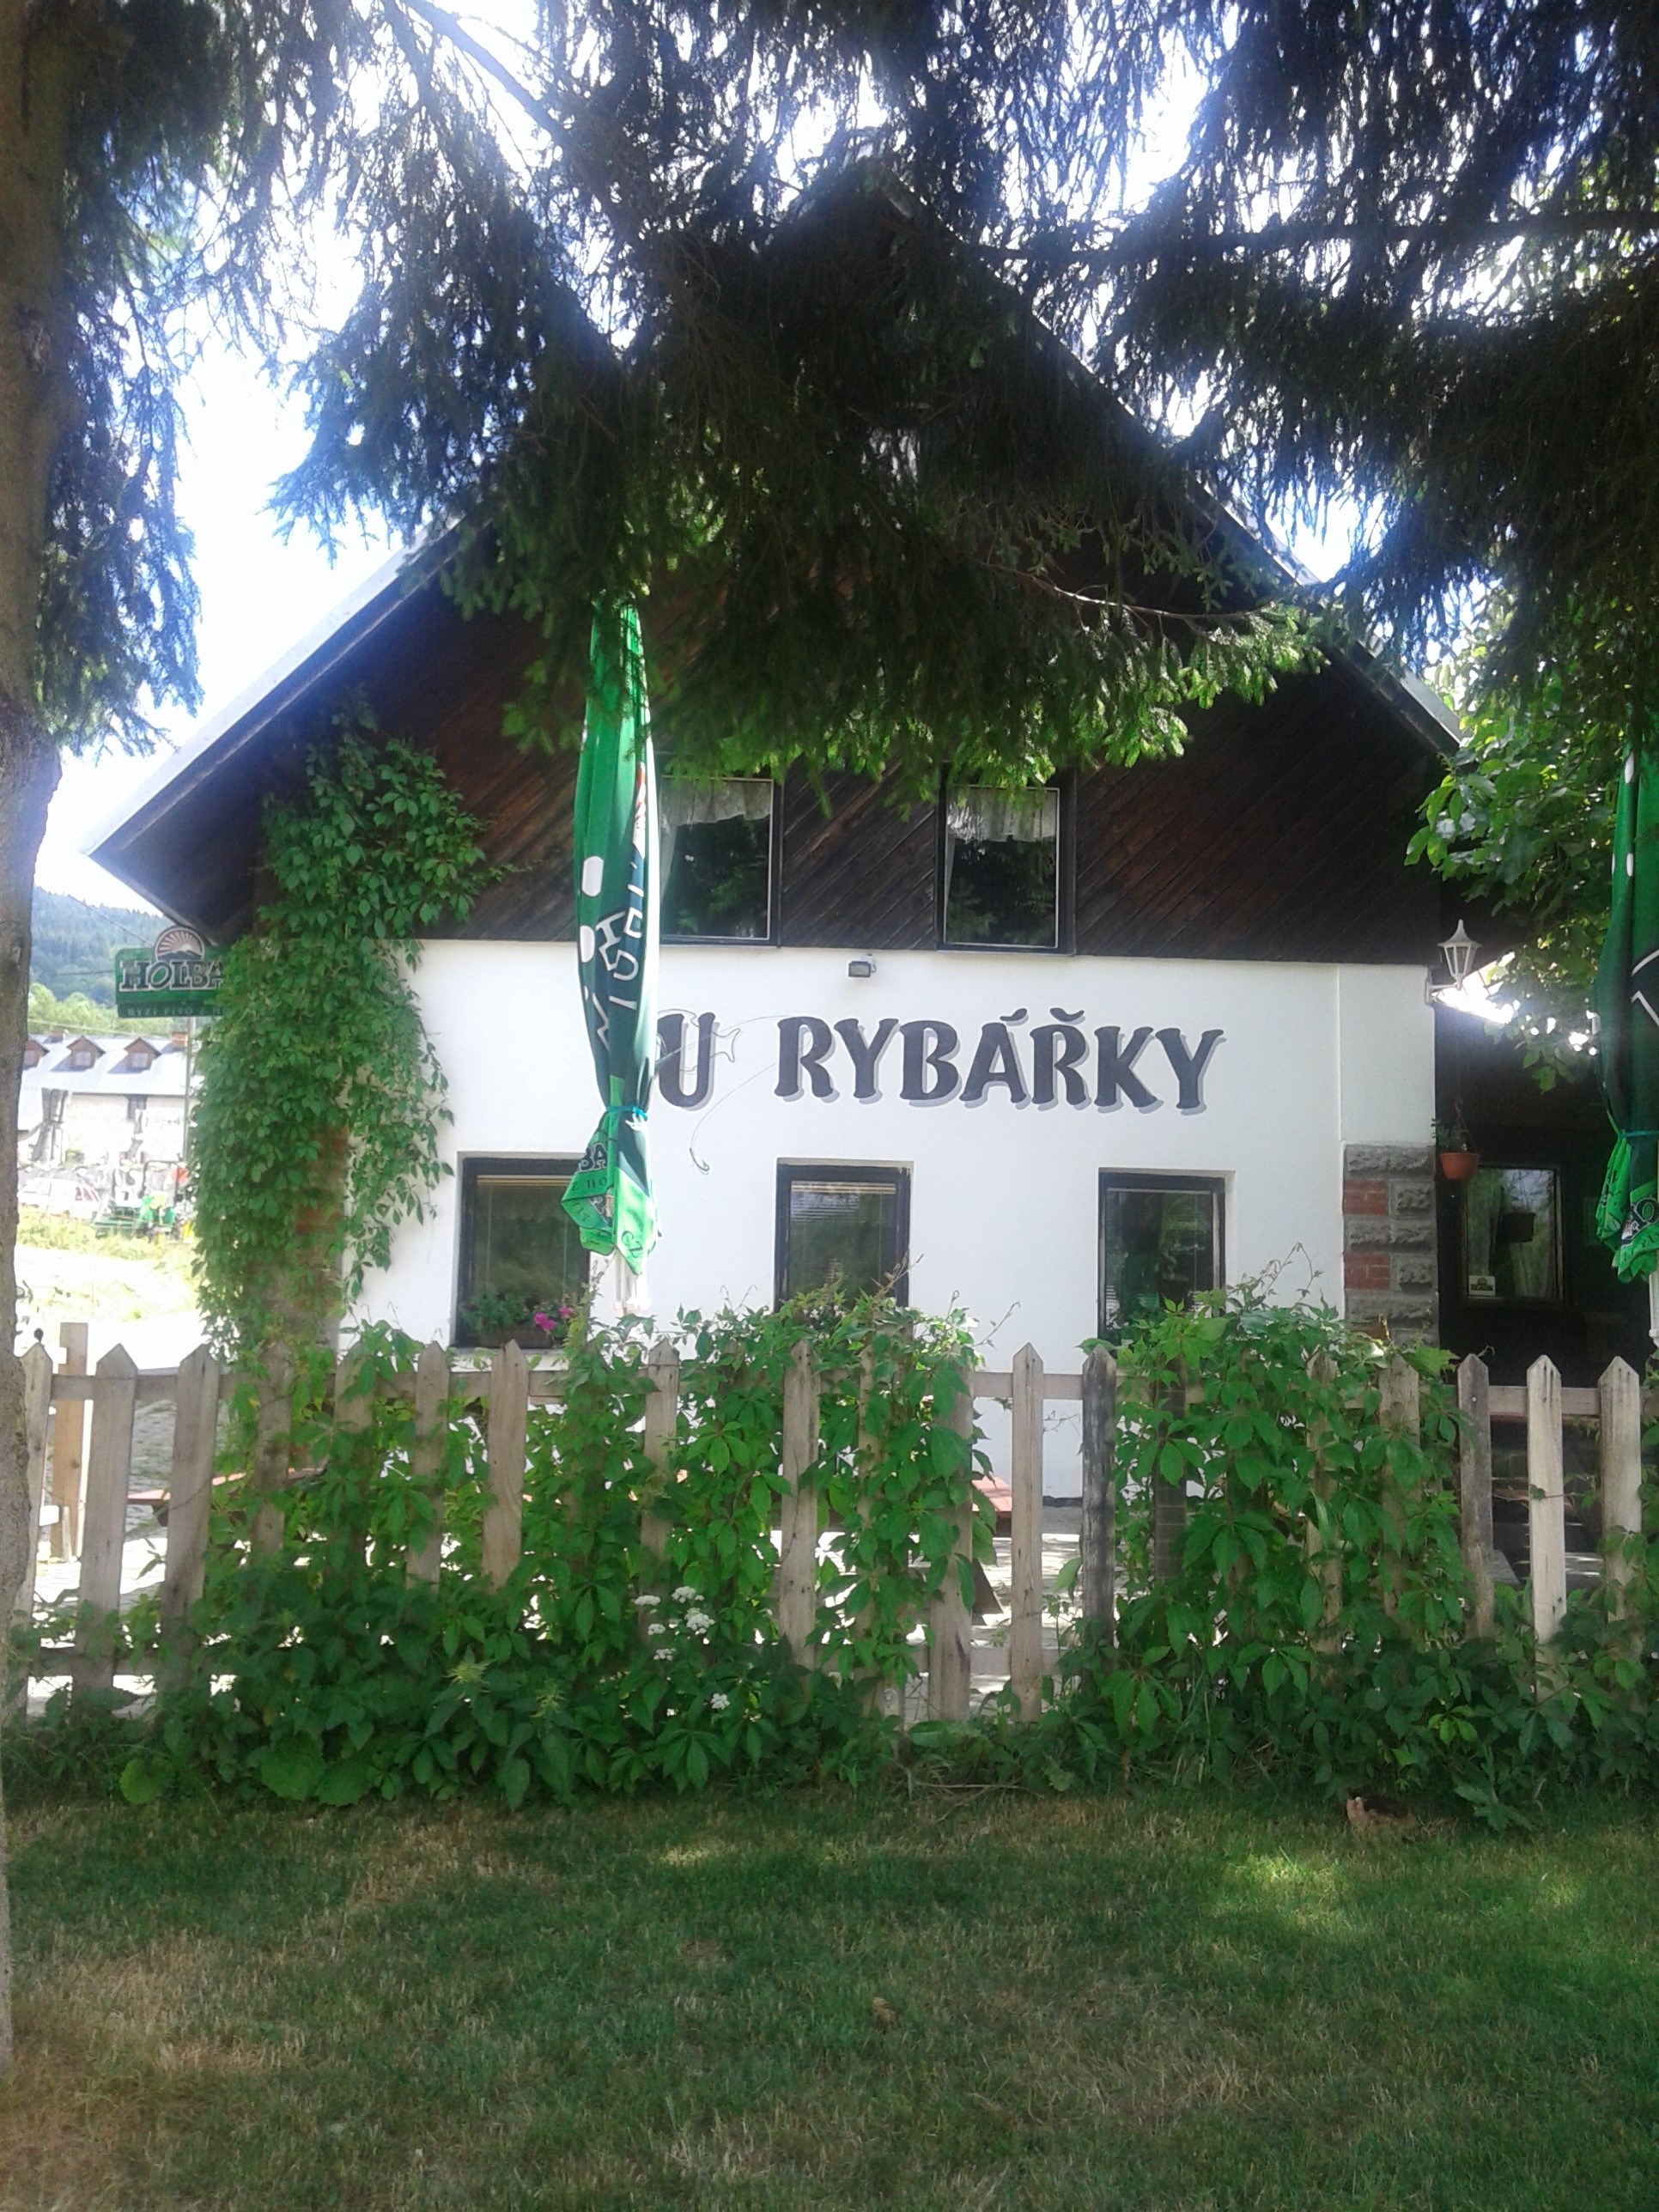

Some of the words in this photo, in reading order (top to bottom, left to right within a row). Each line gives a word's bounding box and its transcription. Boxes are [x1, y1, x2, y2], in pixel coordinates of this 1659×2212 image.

[119, 959, 224, 992] HOLBA
[656, 1011, 720, 1111] U
[776, 1007, 1226, 1115] RYBÁŘKY
